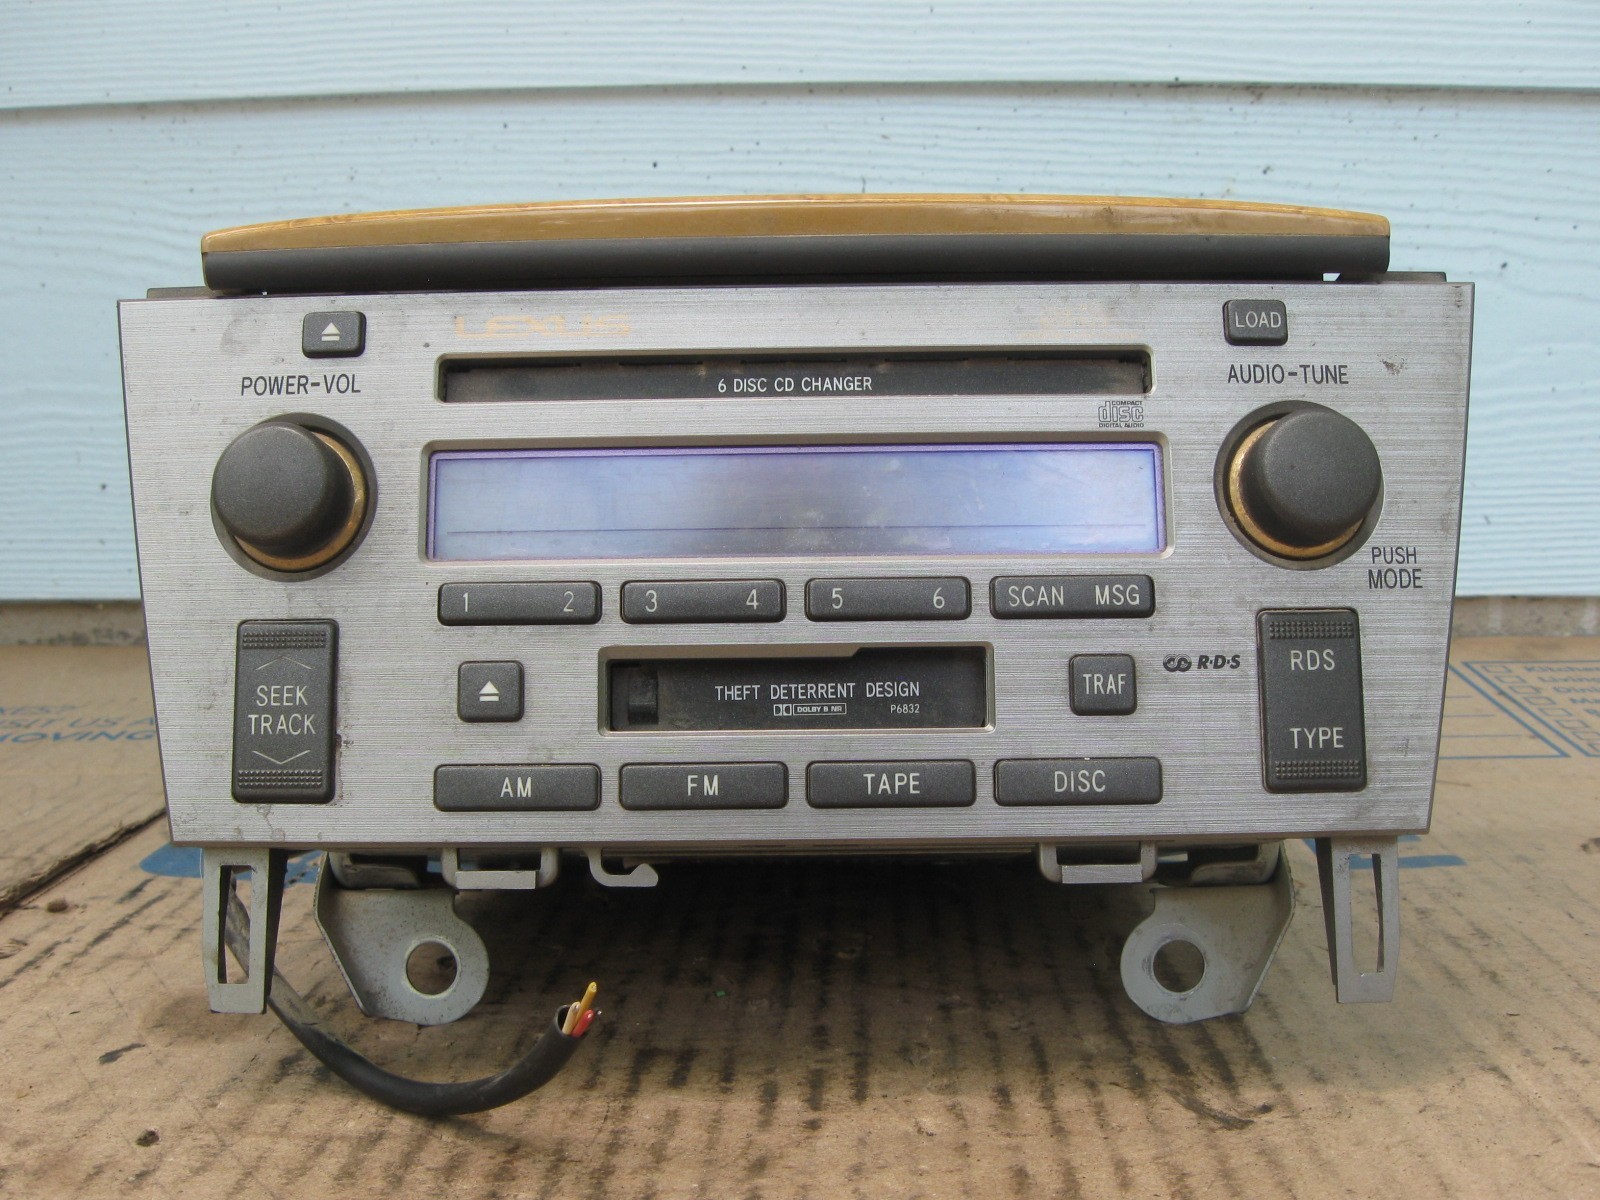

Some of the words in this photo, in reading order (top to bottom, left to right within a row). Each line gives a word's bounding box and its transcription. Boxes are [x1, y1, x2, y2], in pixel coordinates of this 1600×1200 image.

[455, 313, 632, 339] LEXUS
[1234, 310, 1283, 329] LOAD
[240, 373, 361, 397] POWER-VOL
[717, 378, 728, 393] 6
[733, 377, 768, 393] DISC
[774, 377, 795, 392] CD
[801, 376, 873, 392] CHANGER
[1227, 363, 1350, 386] AUDIO-TUNE
[1098, 400, 1144, 422] disc
[1370, 545, 1418, 566] PUSH
[1367, 568, 1423, 590] MODE
[461, 592, 470, 613] 1
[562, 590, 576, 613] 2
[644, 589, 659, 613] 3
[745, 588, 760, 611] 4
[831, 587, 844, 610] 5
[931, 586, 946, 610] 6
[1007, 584, 1065, 608] SCAN
[1094, 583, 1141, 607] MSG
[1289, 648, 1336, 672] RDS
[715, 684, 760, 700] THEFT
[770, 682, 856, 700] DETERRENT
[865, 681, 920, 698] DESIGN
[1081, 672, 1127, 695] TRAF
[255, 684, 309, 707] SEEK
[797, 705, 821, 713] DOLBY
[831, 704, 843, 712] NR
[890, 703, 920, 714] P6832
[247, 713, 316, 736] TRACK
[1289, 726, 1345, 750] TYPE
[500, 776, 533, 799] AM
[686, 774, 720, 797] FM
[862, 772, 921, 796] TAPE
[1053, 769, 1107, 793] DISC
